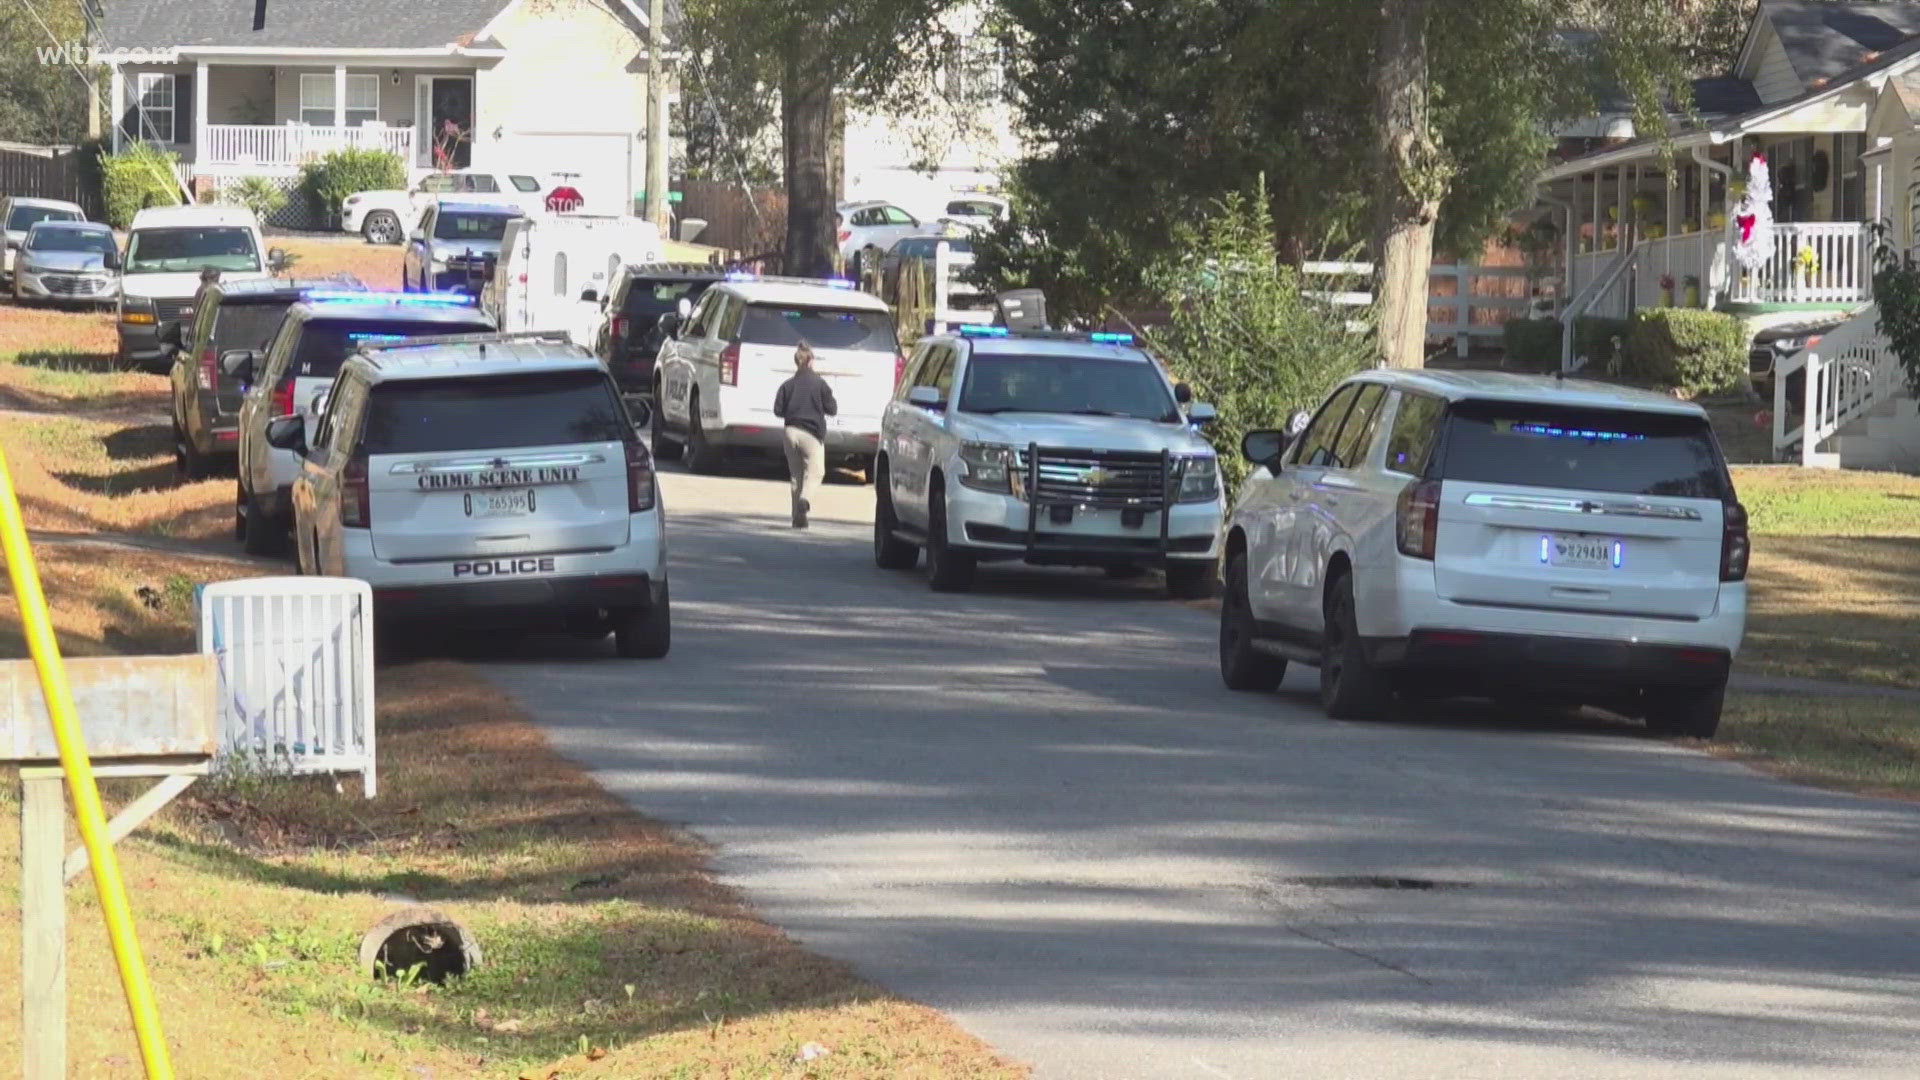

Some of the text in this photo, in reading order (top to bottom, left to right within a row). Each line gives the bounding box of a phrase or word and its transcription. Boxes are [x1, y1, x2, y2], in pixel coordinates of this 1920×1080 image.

[547, 196, 583, 212] STOP
[418, 467, 580, 489] CRIME SCENE UNIT
[453, 558, 555, 577] POLICE
